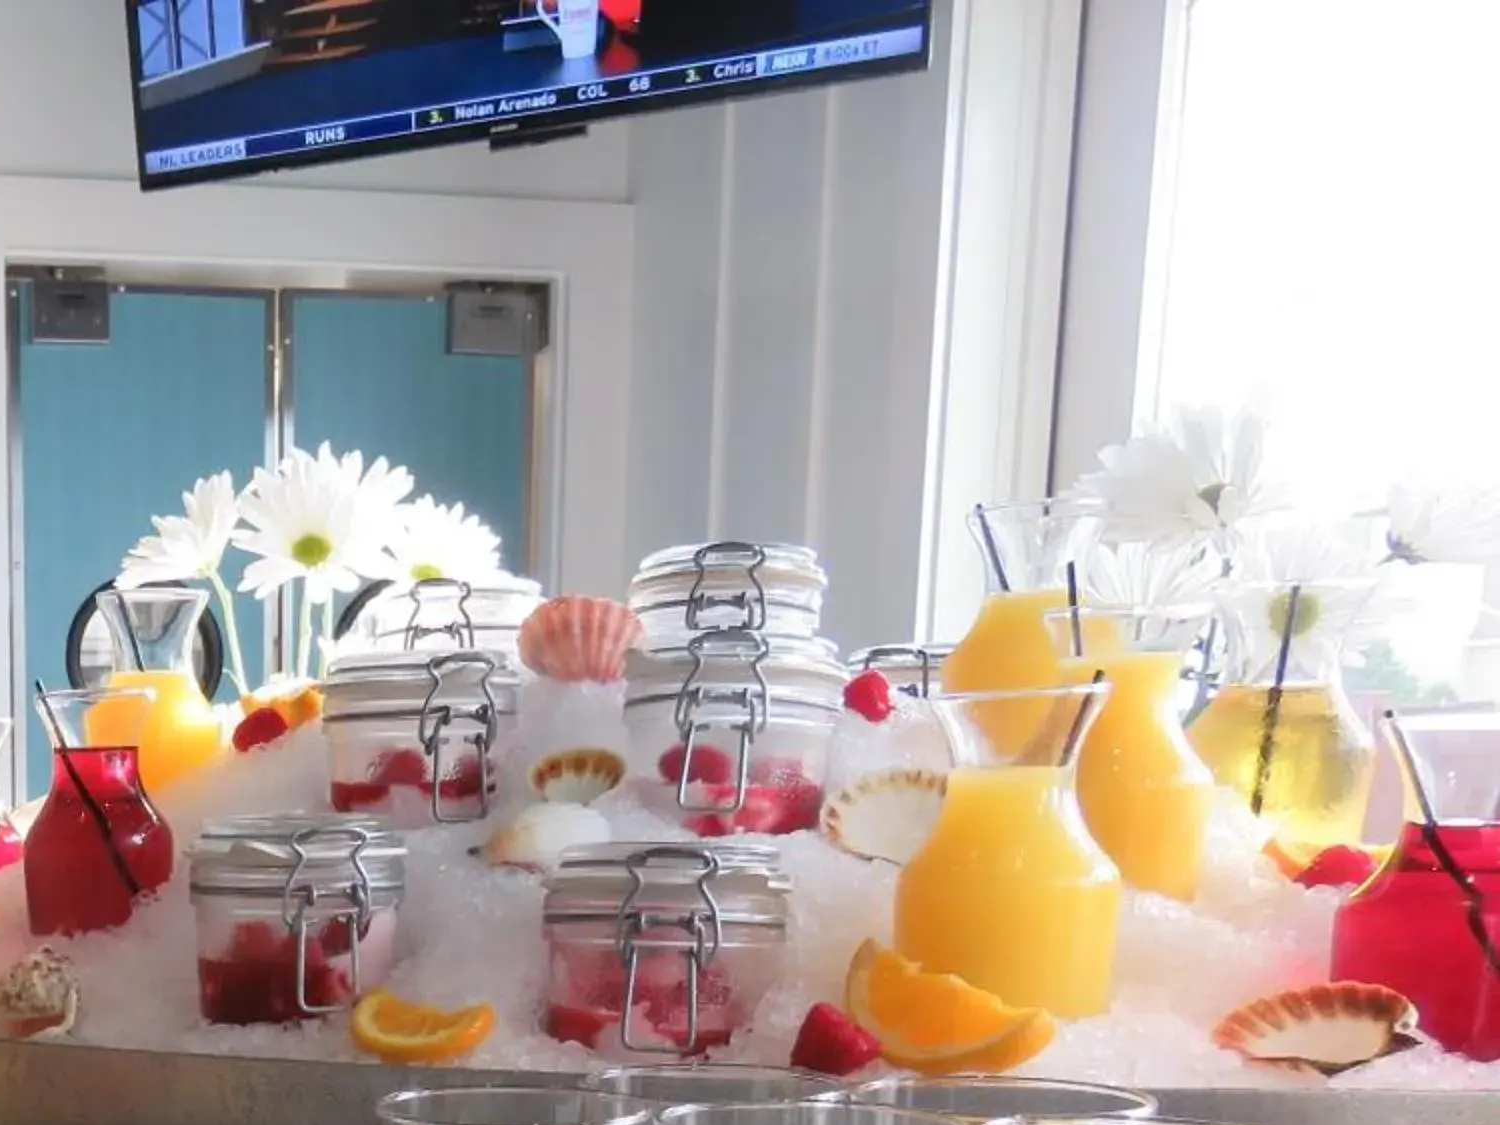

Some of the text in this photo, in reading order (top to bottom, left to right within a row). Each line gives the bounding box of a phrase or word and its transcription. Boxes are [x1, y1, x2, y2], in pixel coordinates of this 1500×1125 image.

[454, 102, 495, 120] Nolan
[498, 92, 557, 113] Arenado
[576, 83, 608, 101] COL
[712, 58, 755, 79] Chris
[304, 126, 346, 146] RUNS
[158, 142, 242, 169] NL LEADERS
